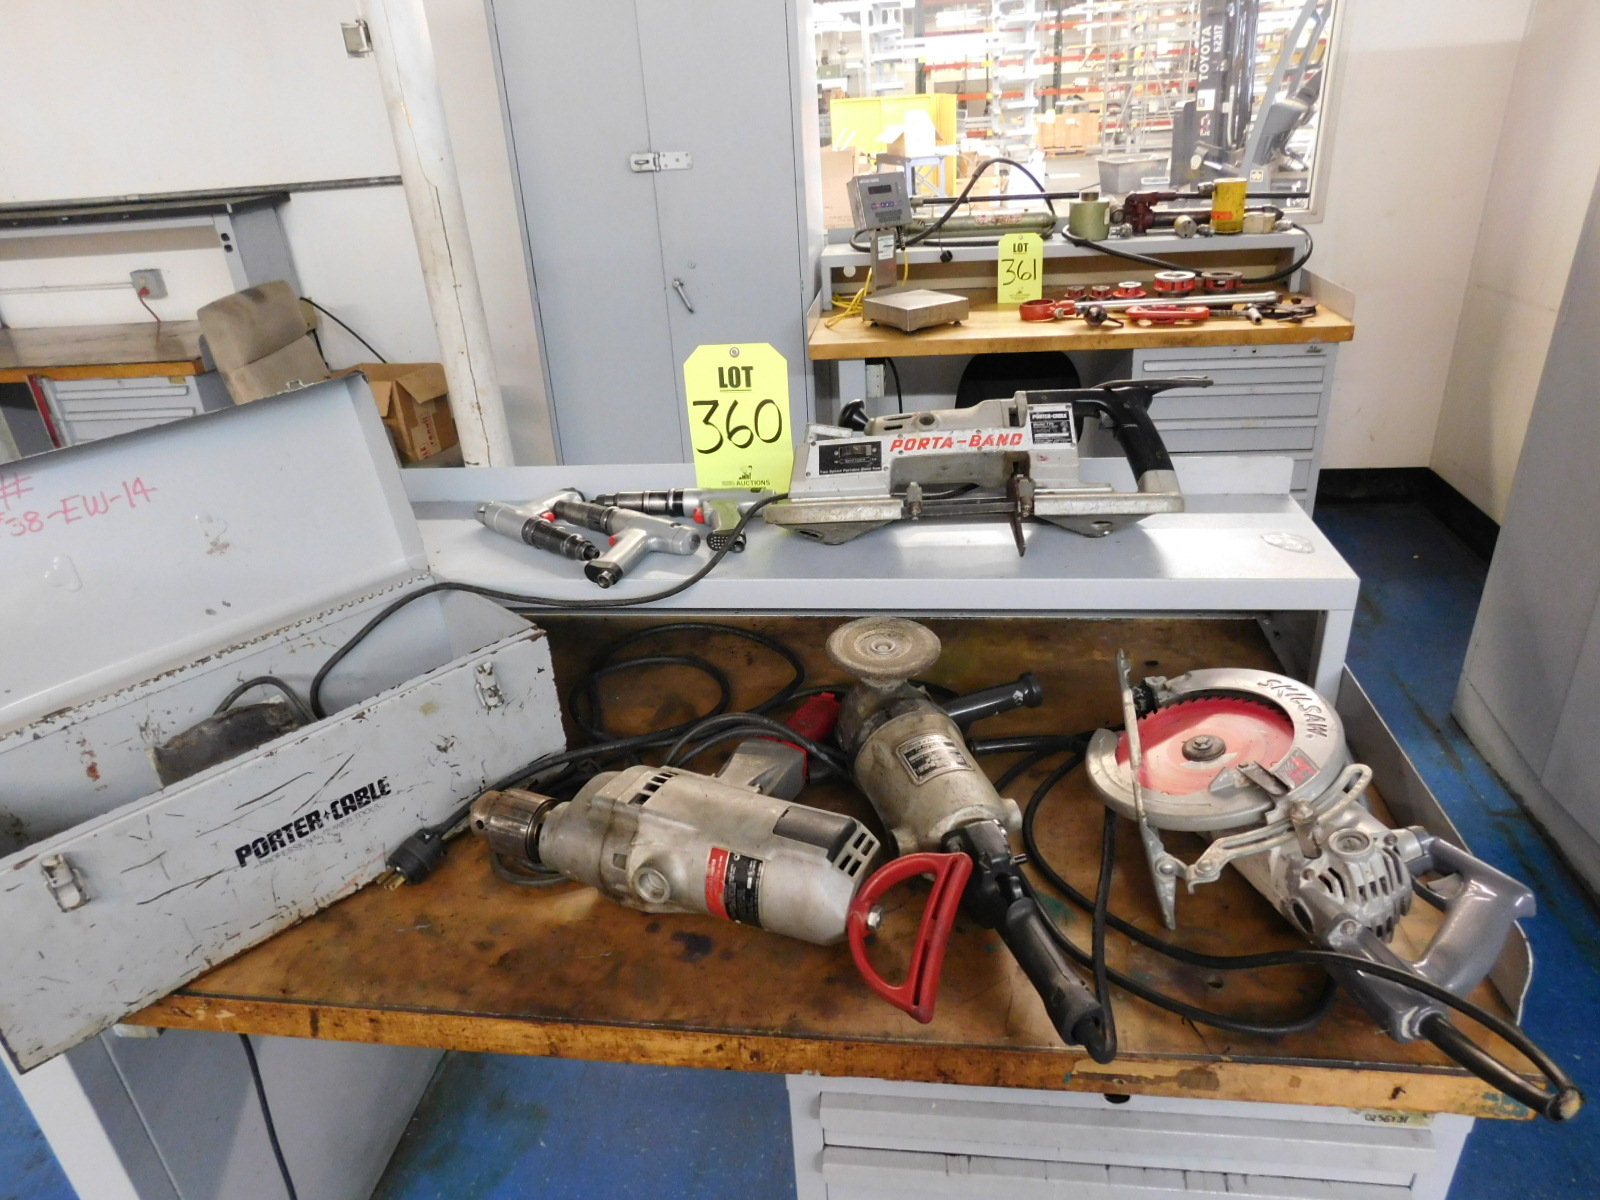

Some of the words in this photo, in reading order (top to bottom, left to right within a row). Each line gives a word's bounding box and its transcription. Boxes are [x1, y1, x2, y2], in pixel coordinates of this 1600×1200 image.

[1199, 25, 1212, 83] TOYOTA
[1013, 242, 1029, 253] LOT
[1001, 258, 1037, 286] 361
[718, 366, 753, 389] LOT
[692, 398, 782, 455] 360
[889, 433, 1024, 452] PORTA-BAND
